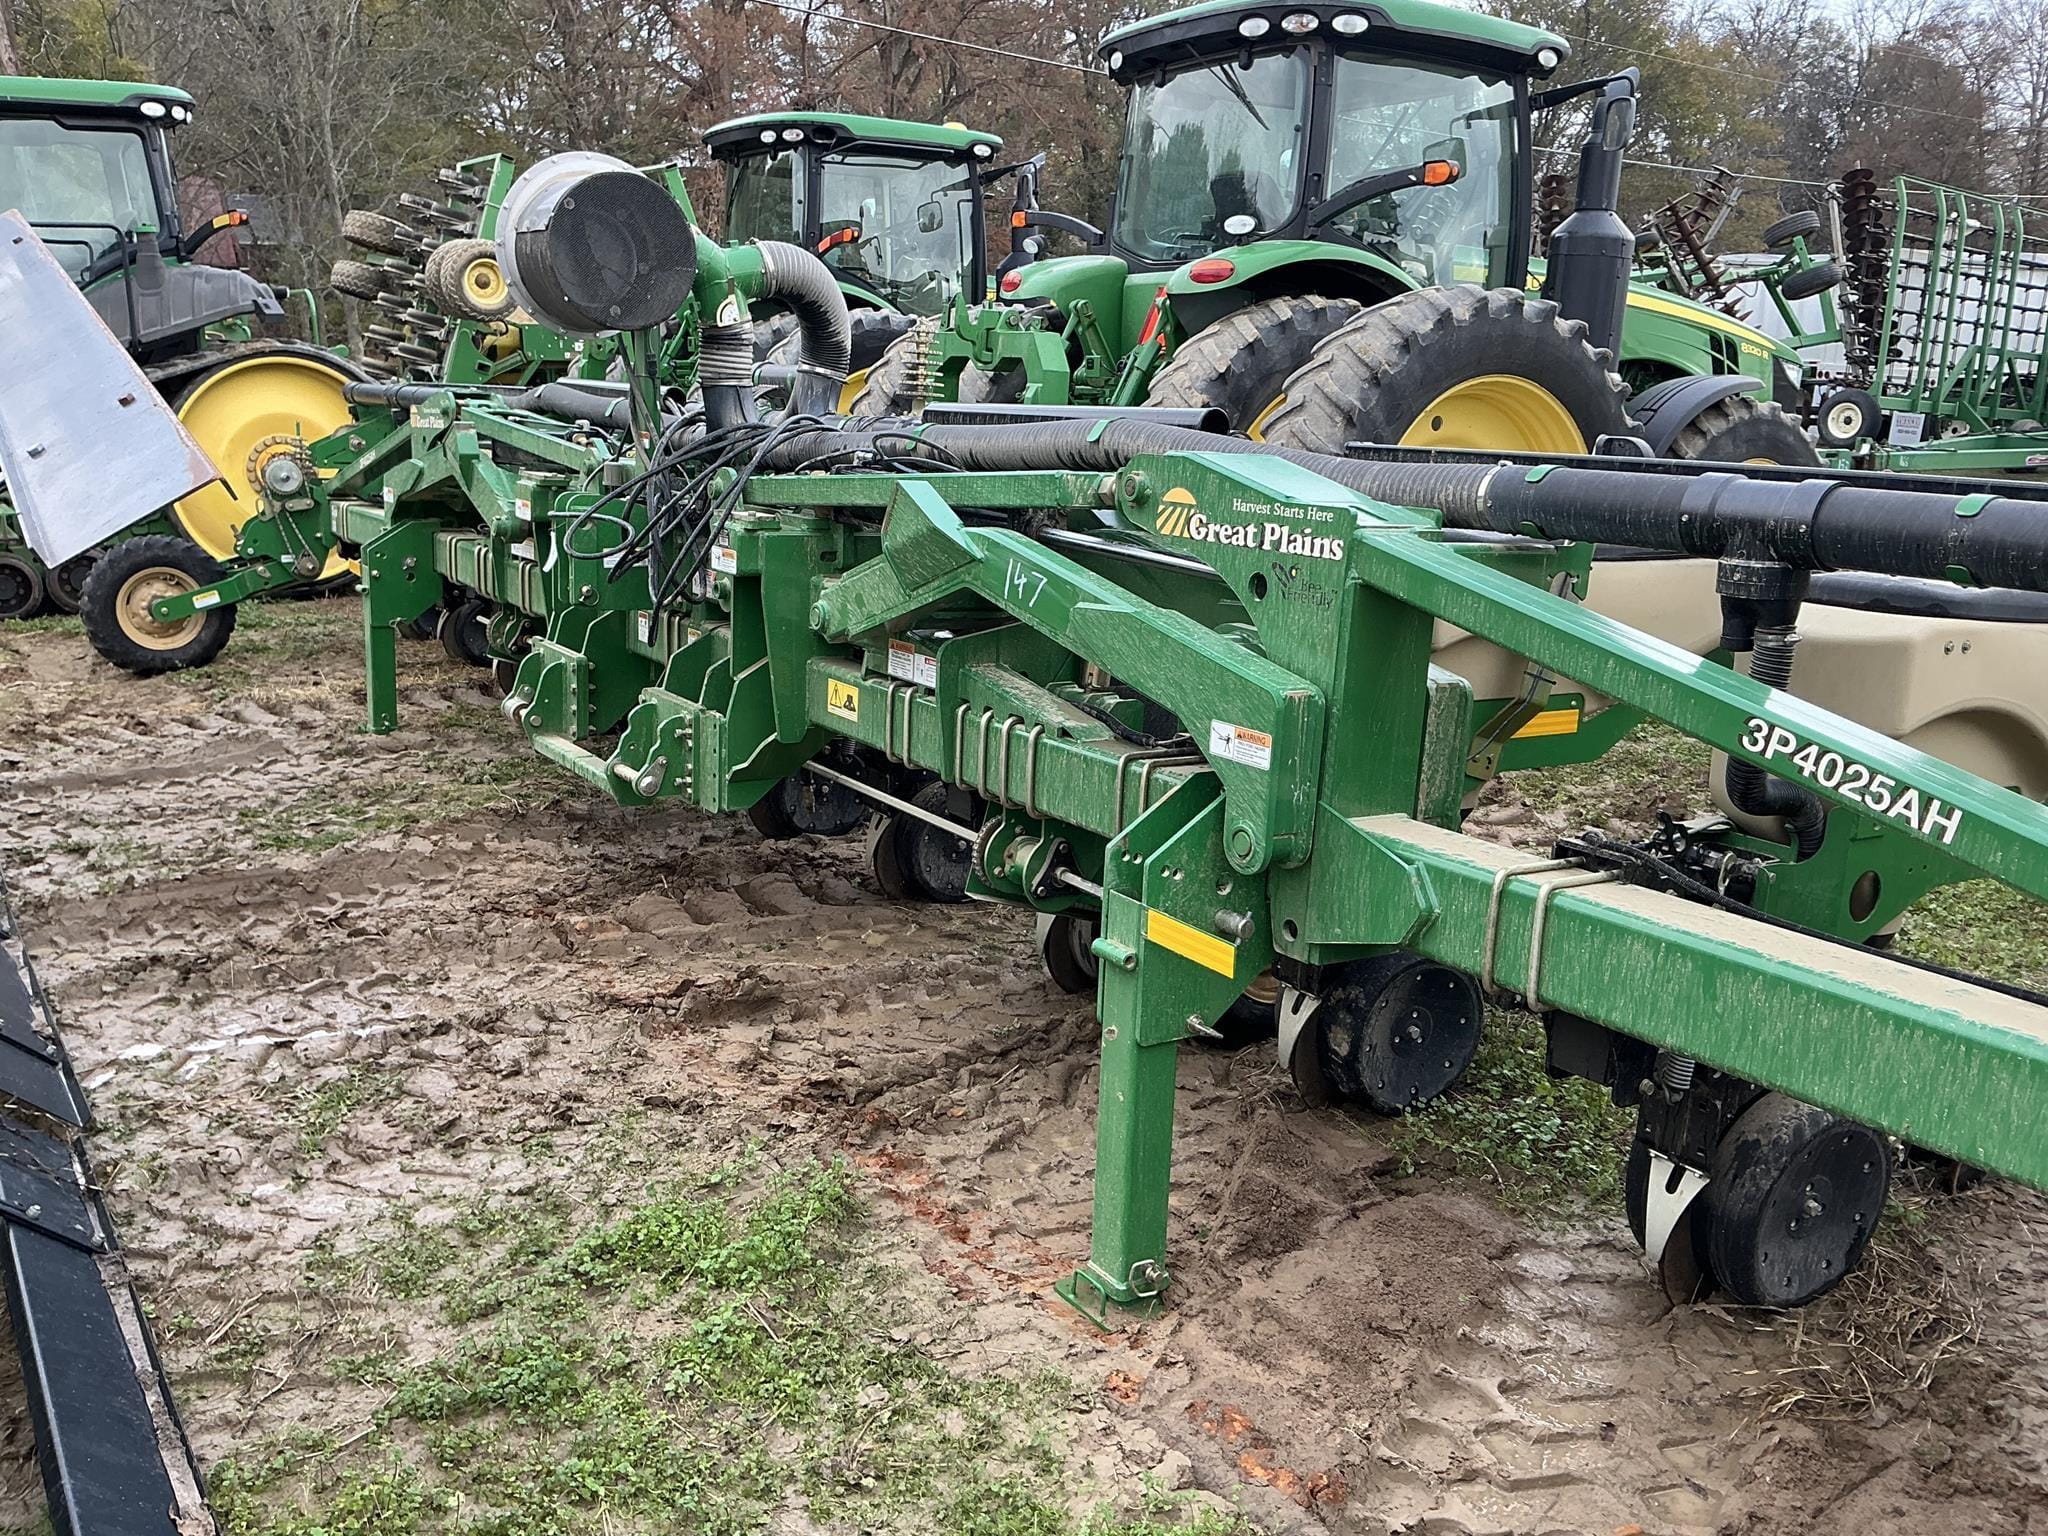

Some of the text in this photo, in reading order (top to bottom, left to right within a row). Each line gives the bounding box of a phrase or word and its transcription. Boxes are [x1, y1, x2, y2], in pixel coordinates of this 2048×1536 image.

[1232, 498, 1334, 522] Harvest Starts Here
[1189, 512, 1344, 561] Great Plains
[1004, 558, 1048, 608] 147
[1301, 579, 1322, 592] Bee
[1242, 731, 1266, 746] WARNING
[1741, 718, 1963, 845] 3P4025AH
